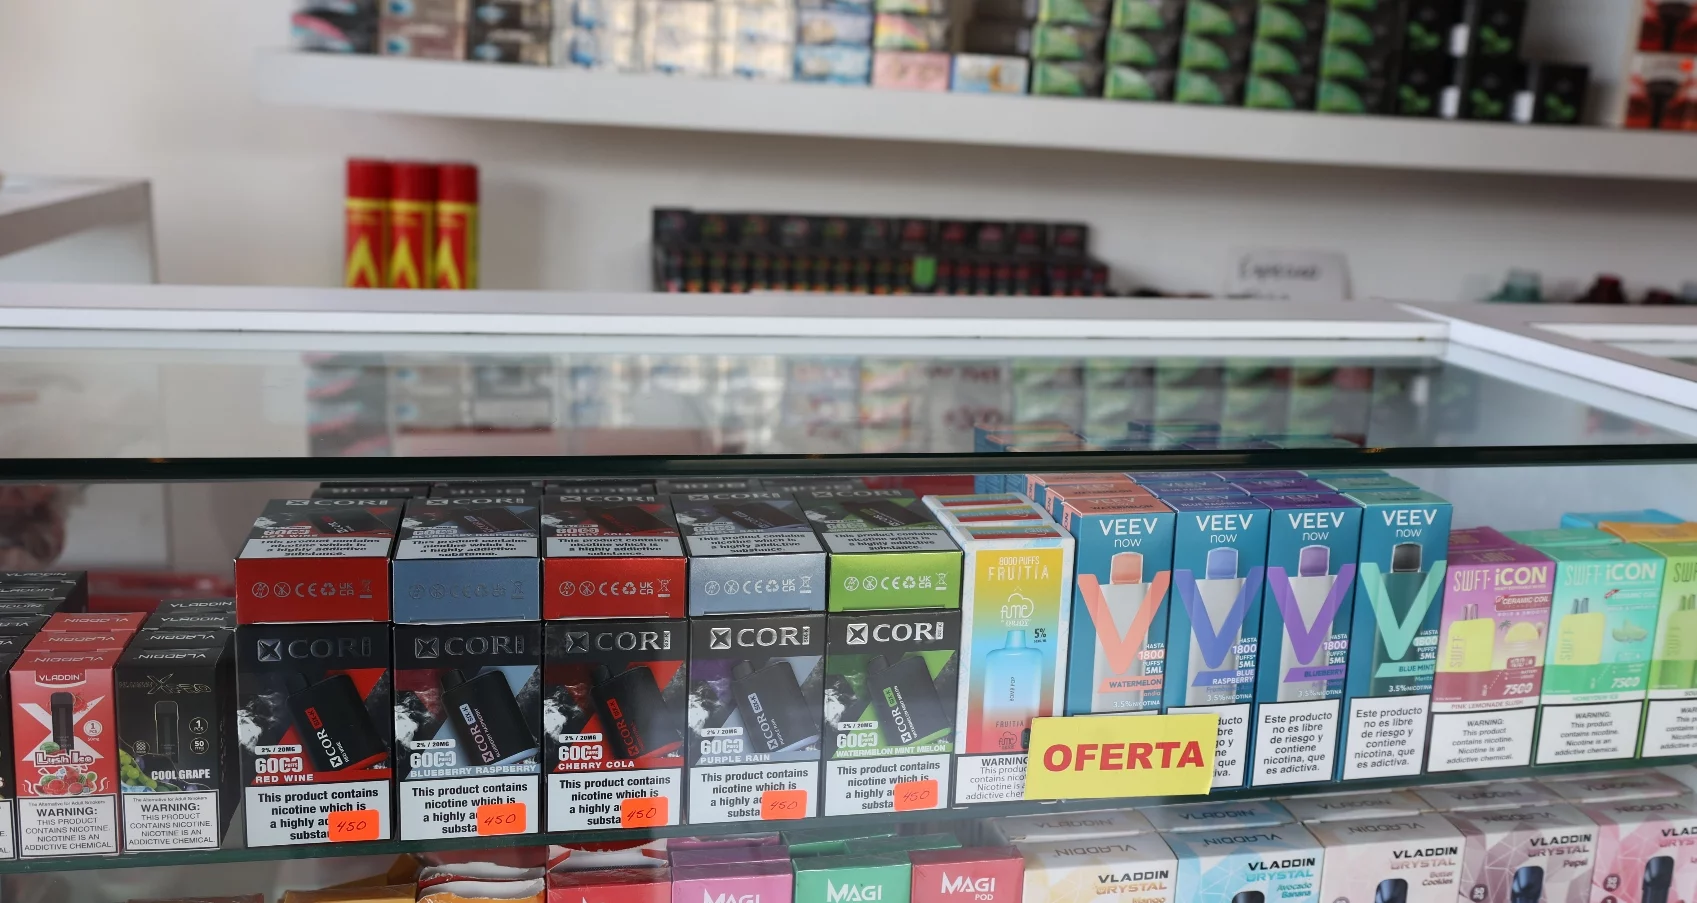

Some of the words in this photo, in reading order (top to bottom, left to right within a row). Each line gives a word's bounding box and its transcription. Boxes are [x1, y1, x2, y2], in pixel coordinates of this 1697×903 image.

[1196, 513, 1254, 532] VEEV
[1288, 512, 1345, 530] VEEV
[1382, 509, 1438, 527] VEEV
[1099, 517, 1158, 536] VEEV
[1210, 533, 1237, 544] now
[1303, 531, 1329, 541] now
[1396, 528, 1422, 538] now
[1114, 538, 1142, 548] now
[999, 556, 1018, 566] 8000
[1019, 555, 1040, 565] PUFFS
[988, 565, 1049, 581] FRUITIA
[1565, 565, 1601, 586] SWFT
[1605, 562, 1658, 581] iCON
[1453, 570, 1488, 592] SWFT
[1494, 567, 1548, 586] iCON
[1232, 644, 1257, 654] 1800
[1323, 640, 1347, 651] 1800
[1138, 649, 1165, 661] 1800
[1329, 656, 1345, 665] 5ML
[1420, 652, 1436, 660] 5ML
[1238, 660, 1255, 668] 5ML
[1399, 665, 1416, 673] BLUE
[1417, 664, 1435, 672] MINT
[39, 674, 80, 682] VLADDIN
[1236, 669, 1255, 677] BLUE
[1304, 669, 1344, 678] BLUEBERRY
[1109, 678, 1162, 689] WATERMELON
[1212, 676, 1254, 685] RASPBERRY
[1611, 677, 1641, 689] 7500
[1503, 682, 1533, 695] 7500
[1264, 715, 1287, 724] Este
[1289, 712, 1332, 724] producto
[1356, 709, 1377, 718] Este
[1380, 707, 1423, 718] producto
[1575, 711, 1612, 720] WARNING:
[1364, 720, 1376, 728] no
[1392, 717, 1413, 727] libre
[1467, 718, 1504, 727] WARNING:
[1587, 720, 1613, 729] product
[1272, 726, 1285, 734] no
[1302, 723, 1323, 733] libre
[1376, 729, 1405, 739] riesgo
[1479, 727, 1507, 736] product
[1560, 730, 1590, 738] contains
[1270, 736, 1282, 744] de
[1285, 734, 1315, 745] riesgo
[1366, 738, 1407, 748] contiene
[1452, 738, 1482, 746] contains
[1484, 736, 1514, 744] nicotine.
[836, 747, 894, 757] WATERMELON
[895, 746, 915, 754] MINT
[917, 744, 946, 753] MELON
[1275, 744, 1317, 754] contiene
[1354, 749, 1395, 759] nicotina,
[1398, 747, 1415, 757] que
[1458, 747, 1487, 755] Nicotine
[35, 751, 70, 765] Lush
[700, 755, 742, 764] PURPLE
[746, 754, 770, 762] RAIN
[1043, 740, 1205, 772] OFERTA
[1263, 755, 1305, 765] nicotina,
[1307, 753, 1326, 763] que
[1446, 756, 1479, 764] addictive
[1480, 754, 1514, 762] chemical.
[558, 762, 601, 770] CHERRY
[606, 761, 635, 769] COLA
[837, 766, 857, 775] This
[860, 764, 897, 776] product
[900, 761, 940, 772] contains
[1370, 758, 1409, 768] adictiva.
[151, 770, 177, 780] COOL
[178, 769, 211, 780] GRAPE
[411, 768, 472, 778] BLUEBERRY
[475, 765, 537, 775] RASPBERRY
[980, 766, 996, 775] This
[1280, 764, 1320, 774] adictiva.
[255, 775, 279, 783] RED
[284, 774, 314, 782] WINE
[701, 773, 722, 783] This
[725, 771, 763, 783] product
[766, 769, 809, 779] contains
[847, 777, 886, 787] nicotine
[889, 775, 918, 784] which
[970, 775, 1005, 784] contains
[560, 780, 581, 789] This
[584, 778, 625, 790] product
[627, 776, 671, 786] contains
[712, 784, 752, 795] nicotine
[755, 782, 785, 791] which
[977, 783, 1010, 792] Nicotine
[412, 787, 434, 797] This
[438, 785, 480, 798] product
[482, 782, 528, 794] contains
[571, 791, 613, 801] nicotine
[616, 789, 647, 799] which
[854, 789, 884, 801] highly
[258, 793, 281, 803] This
[285, 791, 328, 804] product
[331, 788, 379, 800] contains
[903, 790, 930, 803] 450
[965, 791, 1004, 801] addictive
[424, 799, 468, 810] nicotine
[471, 797, 503, 806] which
[719, 796, 750, 808] highly
[770, 800, 798, 811] 450
[36, 807, 98, 817] WARNING:
[141, 803, 201, 813] WARNING:
[271, 805, 316, 816] nicotine
[320, 802, 353, 812] which
[578, 803, 610, 815] highly
[433, 811, 466, 824] highly
[627, 807, 657, 821] 450
[1179, 809, 1255, 821] VLADDIN
[58, 817, 97, 825] PRODUCT
[173, 820, 213, 828] NICOTINE.
[280, 817, 314, 830] highly
[484, 814, 516, 826] 450
[25, 827, 68, 835] CONTAINS
[69, 825, 110, 833] NICOTINE.
[336, 820, 367, 833] 450
[1347, 821, 1424, 835] VLADDIN
[37, 834, 76, 843] NICOTINE
[128, 838, 171, 846] ADDICTIVE
[173, 837, 215, 845] CHEMICAL.
[1203, 833, 1283, 847] VLADDIN
[1530, 833, 1592, 847] VLADDIN
[24, 843, 68, 851] ADDICTIVE
[69, 841, 114, 849] CHEMICAL.
[1393, 846, 1459, 859] VLADDIN
[1248, 857, 1316, 871] VLADDIN
[1562, 856, 1588, 869] Pepsi
[941, 871, 996, 894] MAGI
[1098, 870, 1170, 884] VLADDIN
[1422, 877, 1453, 887] Cookies
[827, 879, 883, 903] MAGI
[1276, 881, 1312, 892] Avocado
[974, 893, 994, 901] POD
[1281, 889, 1312, 899] Banana
